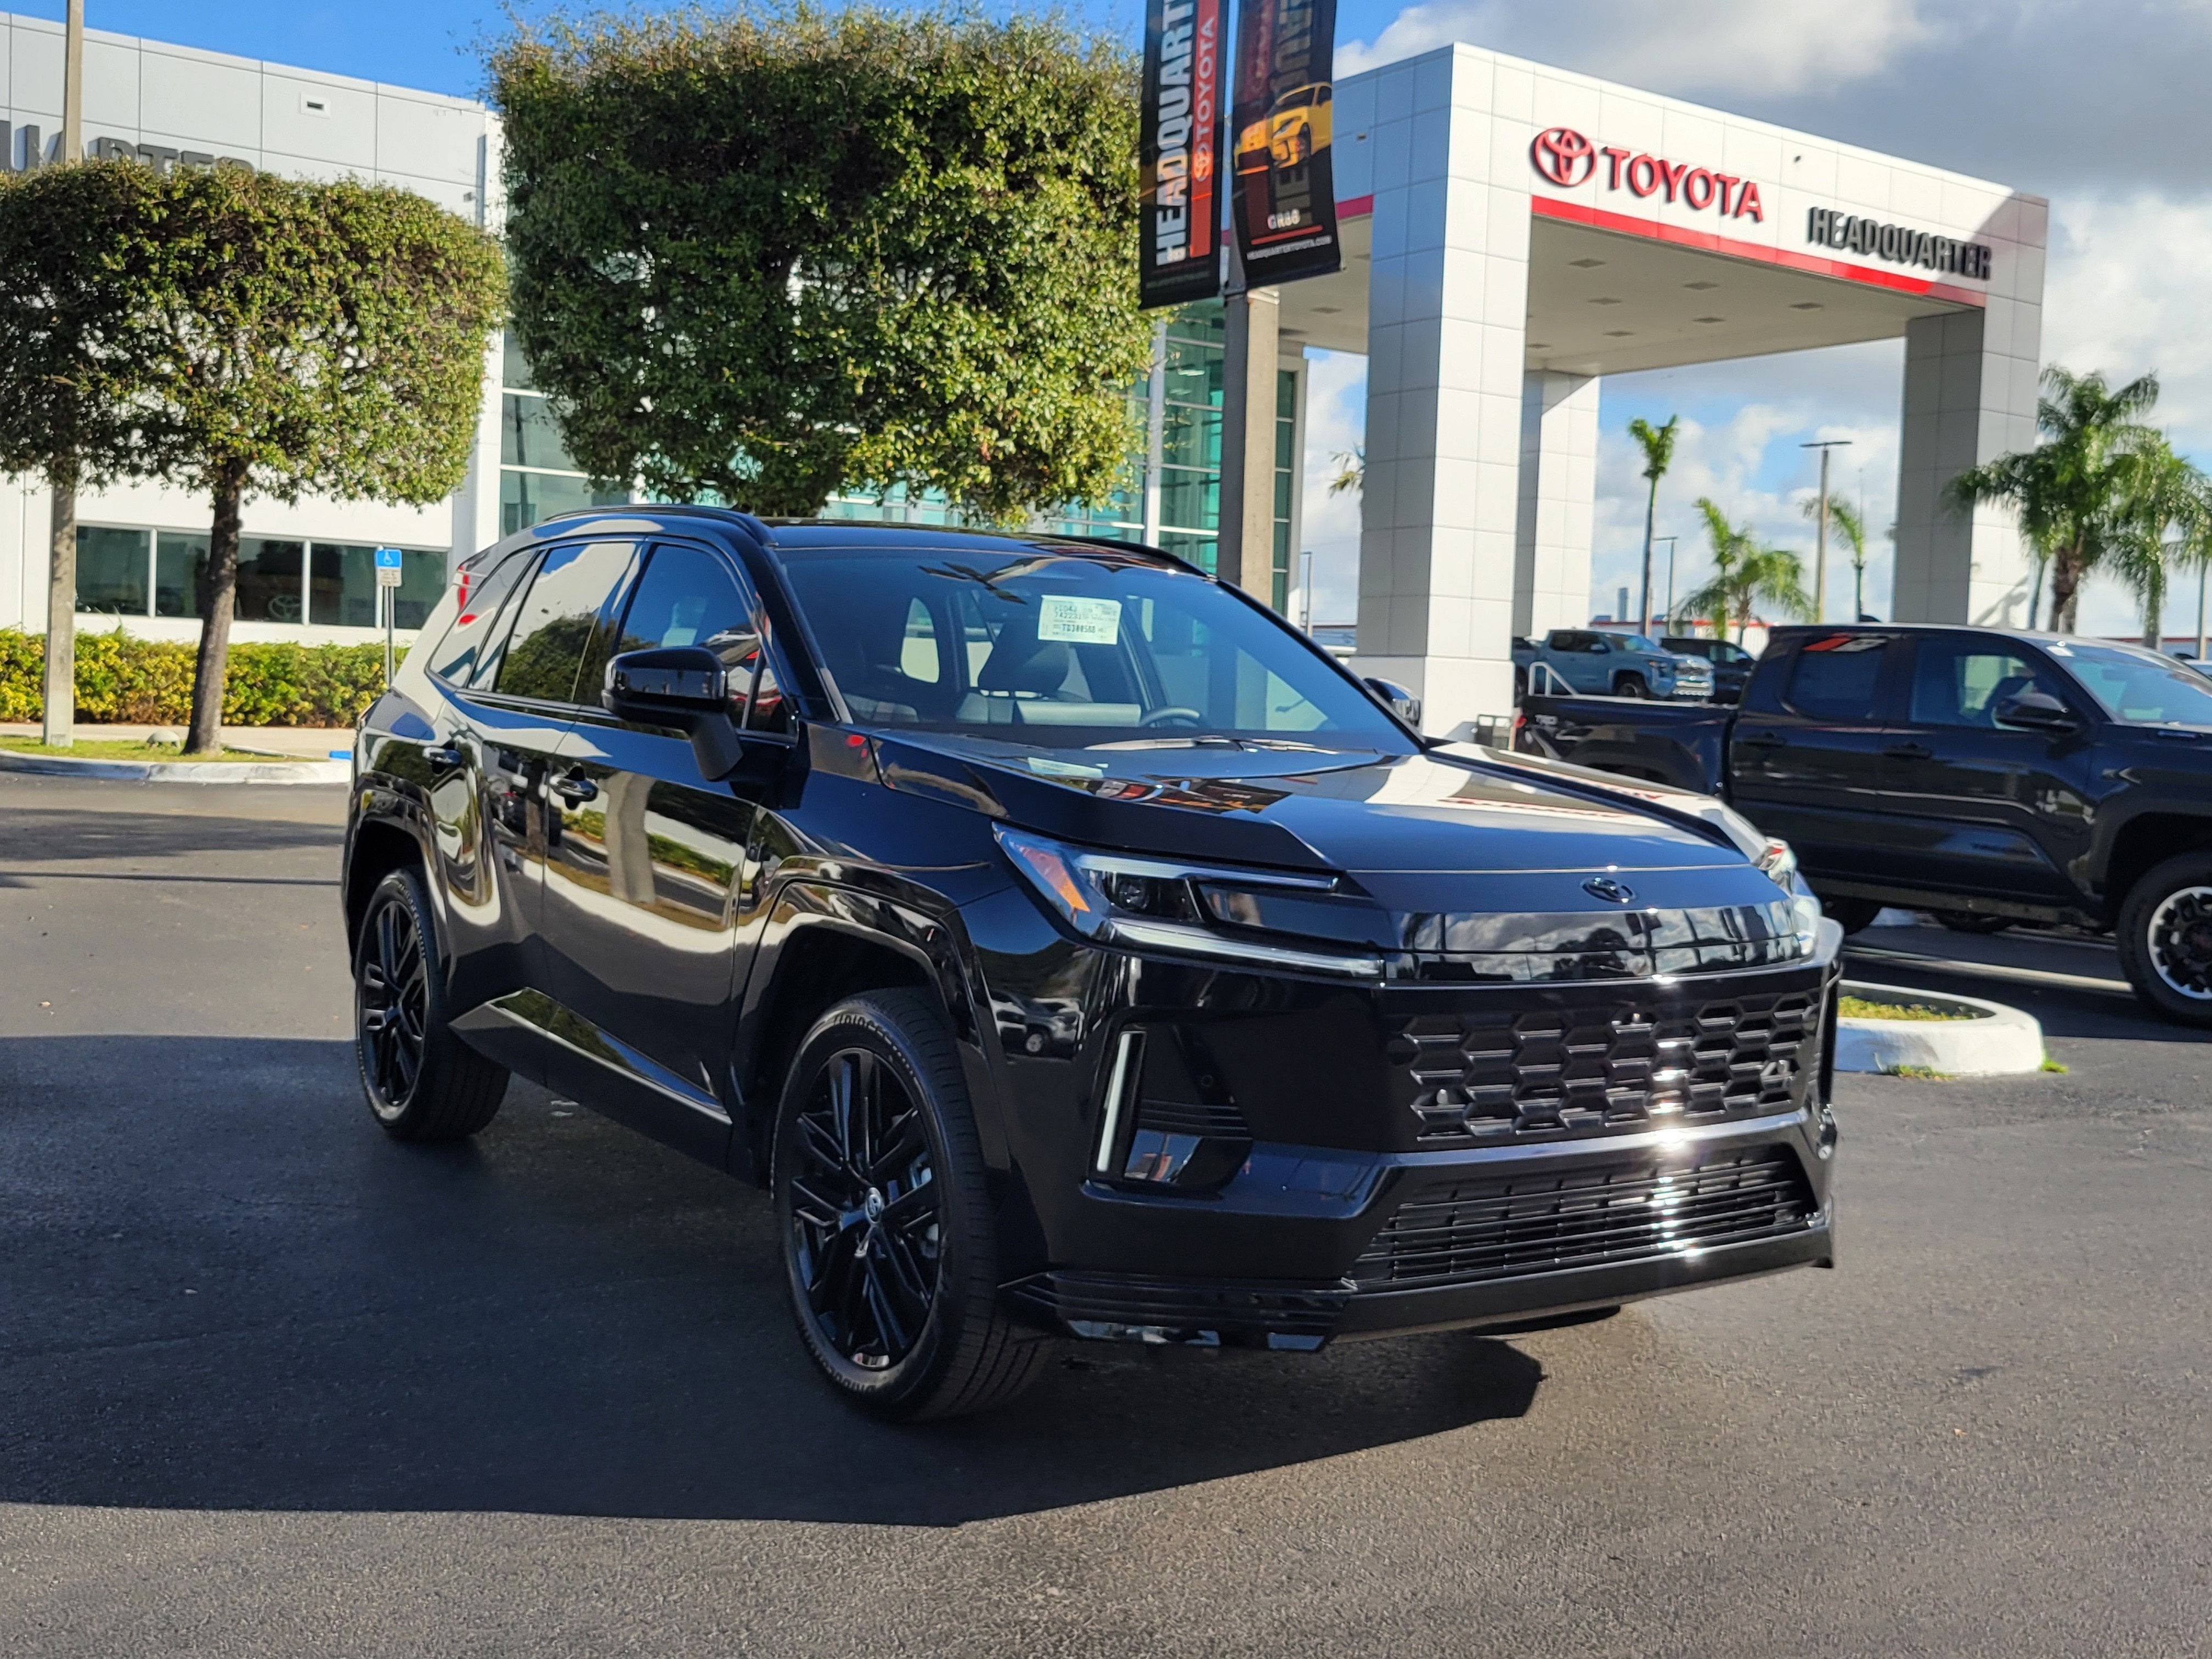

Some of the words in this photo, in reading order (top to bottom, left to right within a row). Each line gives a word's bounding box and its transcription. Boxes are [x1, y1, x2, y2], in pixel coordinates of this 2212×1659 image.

[1197, 16, 1215, 141] TOYOTA
[1156, 0, 1194, 266] HEADQUART
[1267, 208, 1300, 229] GR86
[1601, 145, 1764, 222] TOYOTA
[1808, 206, 1992, 280] HEADQUARTER
